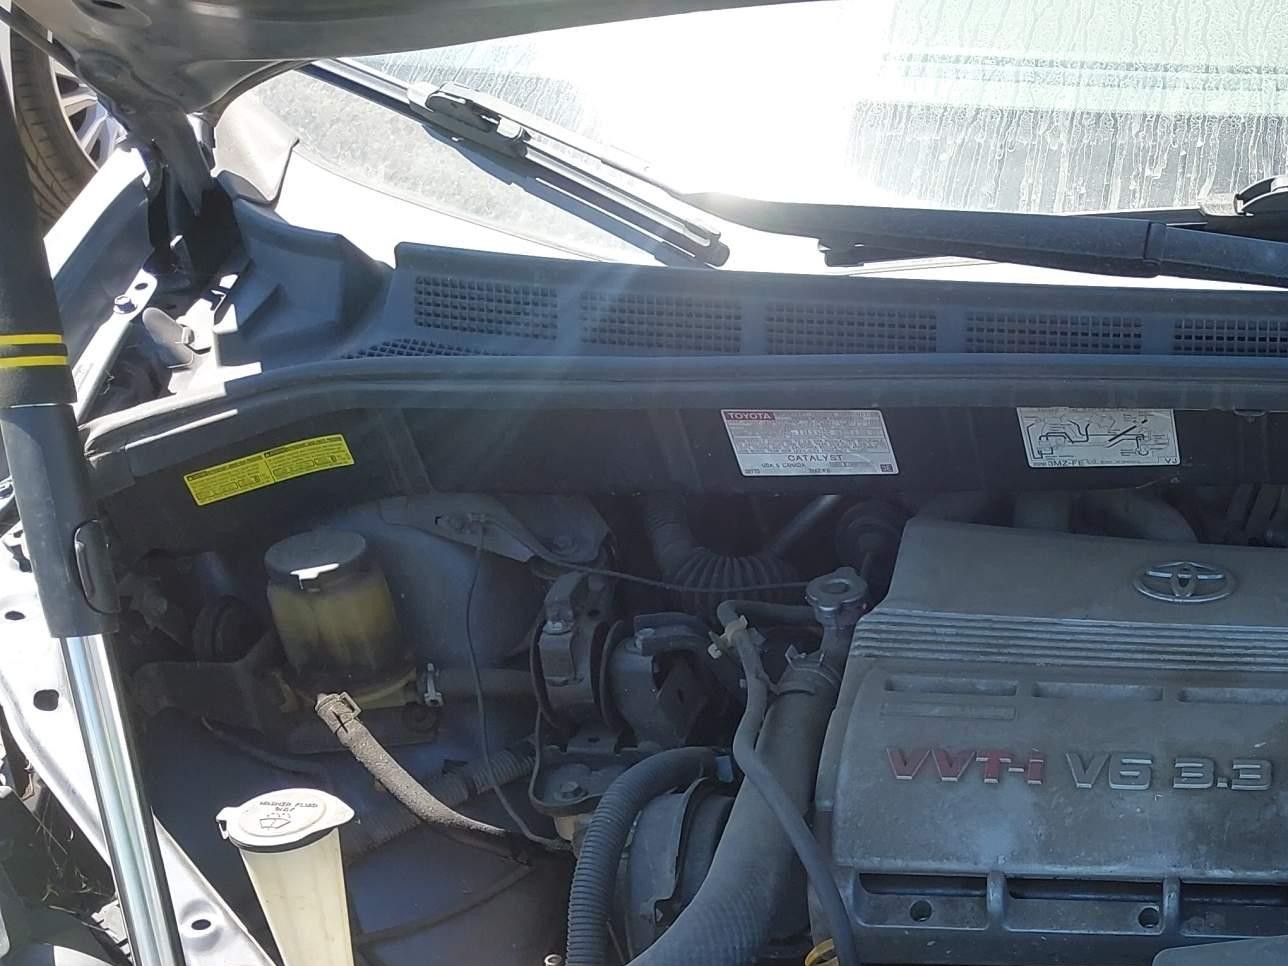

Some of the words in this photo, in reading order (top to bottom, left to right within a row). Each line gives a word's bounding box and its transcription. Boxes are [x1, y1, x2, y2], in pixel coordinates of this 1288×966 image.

[728, 412, 772, 420] TOYOTA
[787, 454, 843, 462] CATALYST
[1065, 752, 1153, 791] V6
[1171, 756, 1273, 791] 3.3
